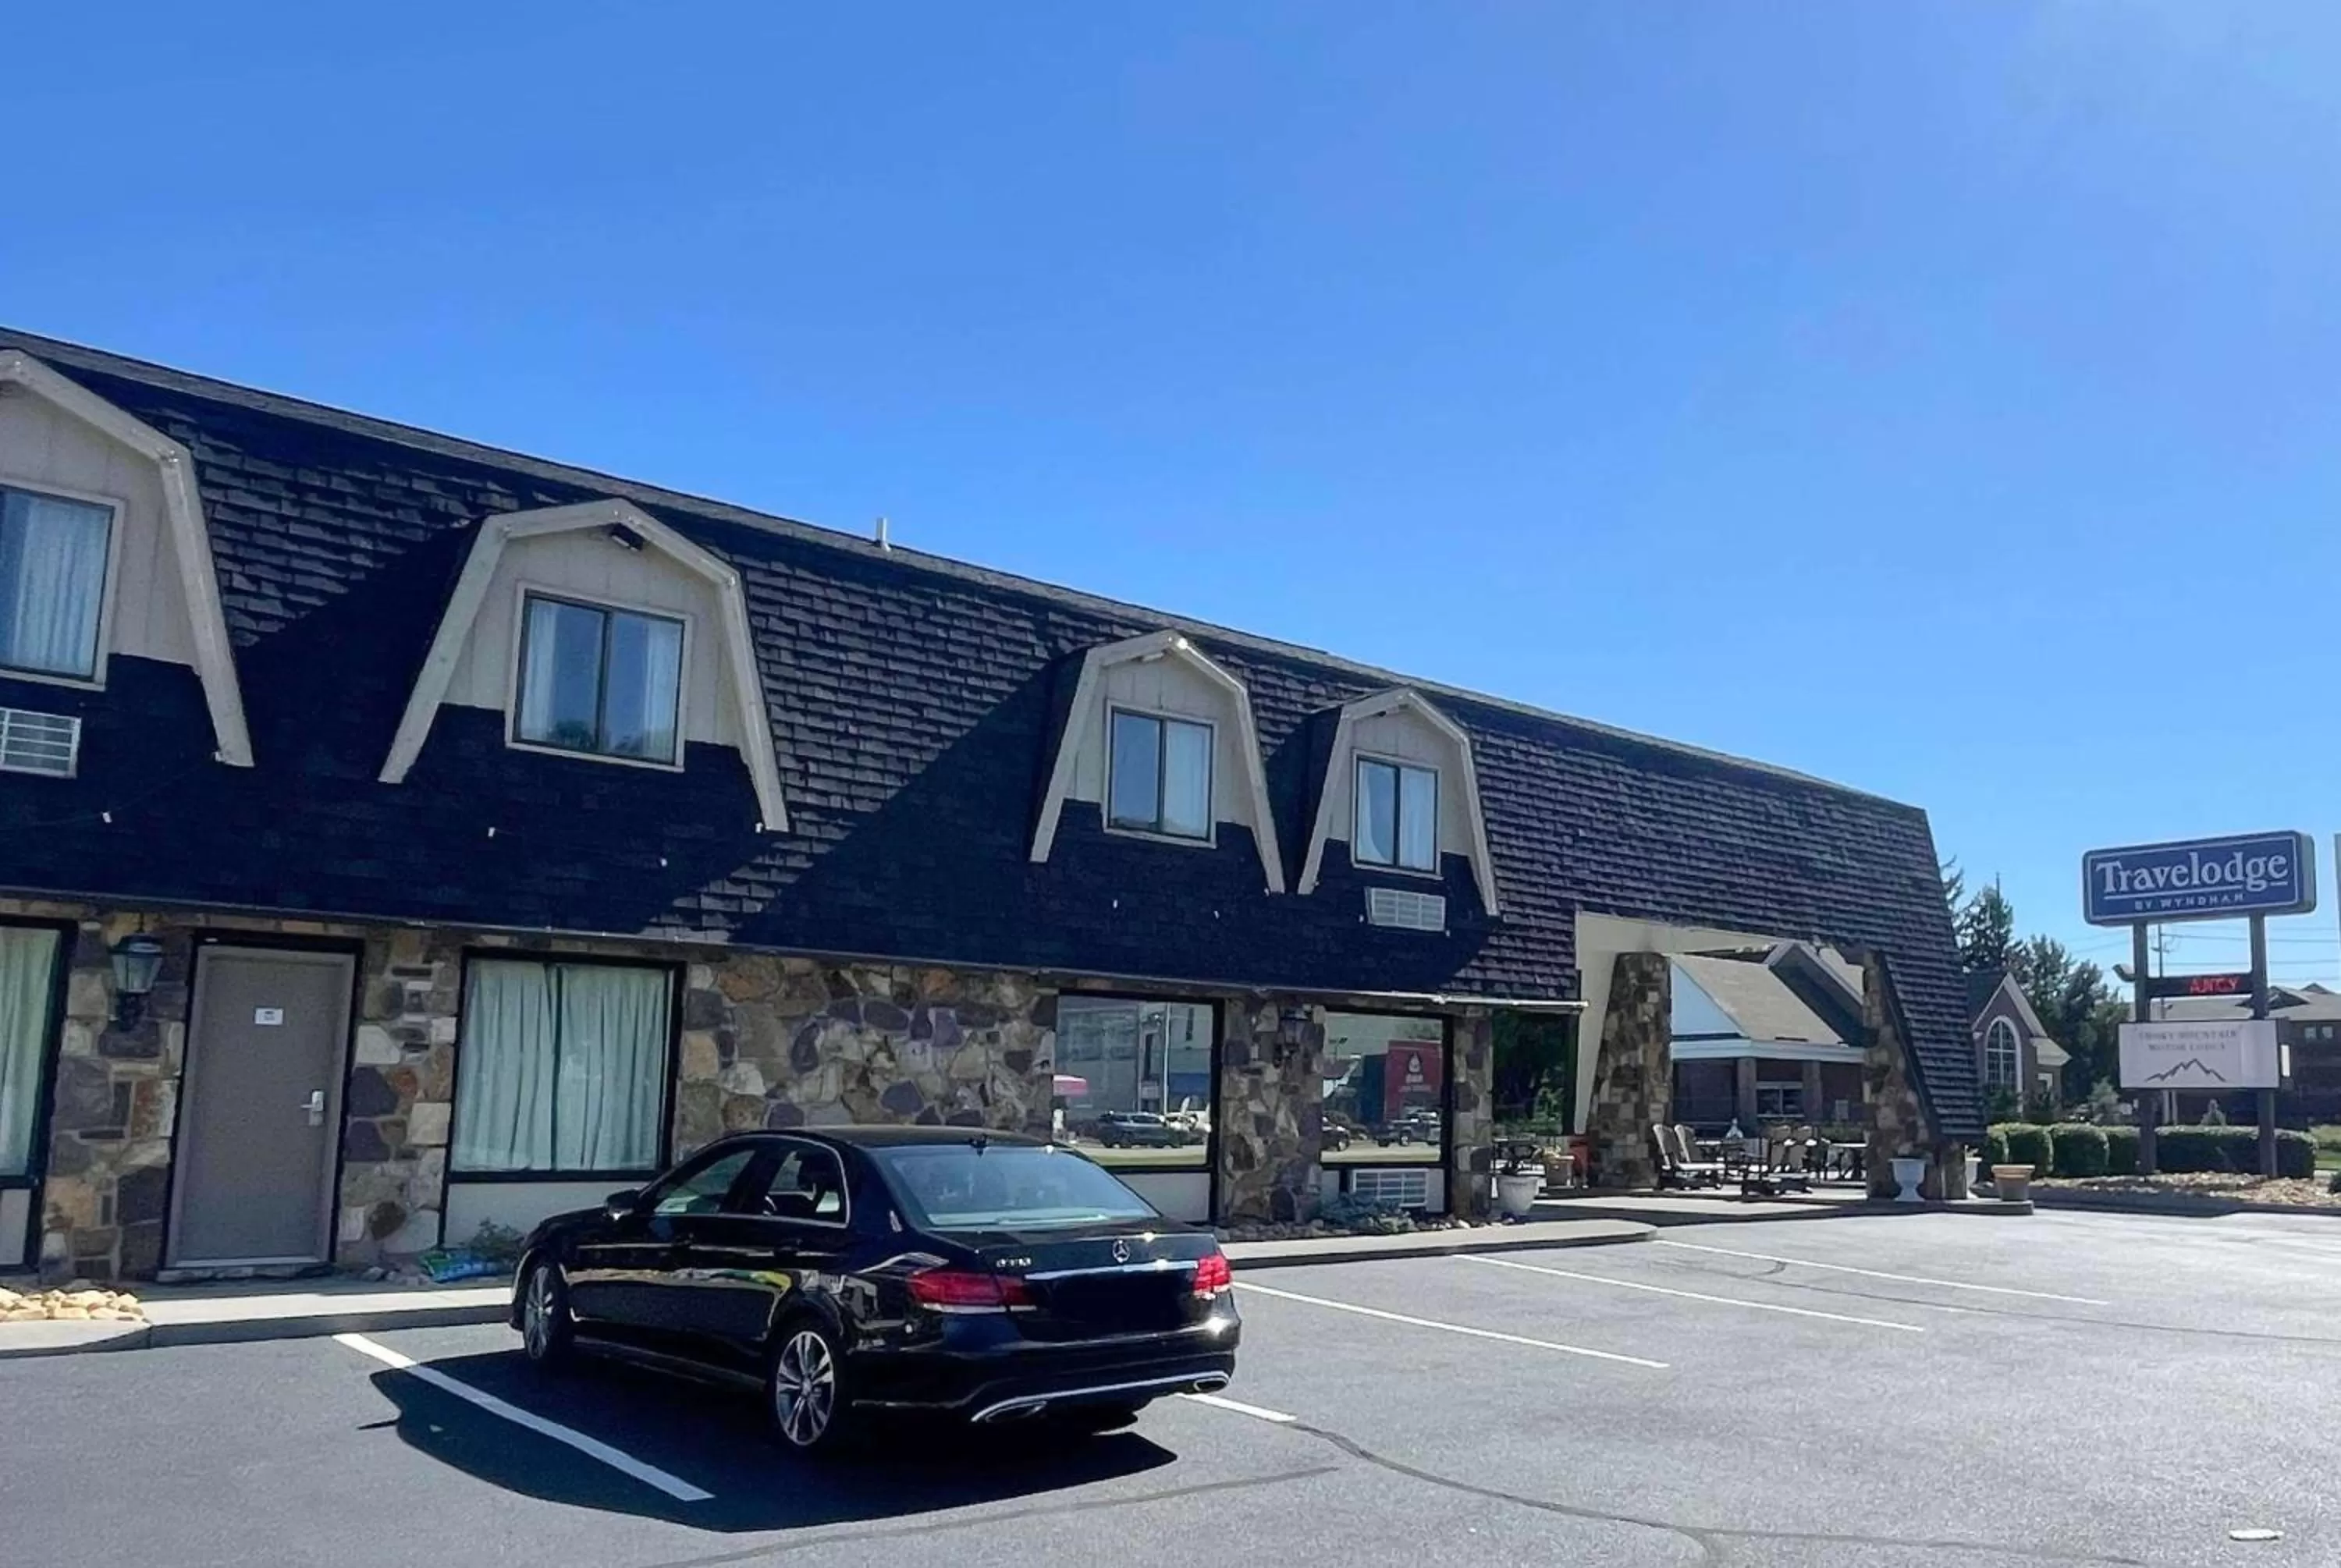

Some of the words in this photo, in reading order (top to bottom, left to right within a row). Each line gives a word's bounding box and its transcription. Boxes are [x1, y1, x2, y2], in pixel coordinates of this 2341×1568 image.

[2095, 851, 2289, 893] Travelodge
[2134, 899, 2152, 911] BY
[2160, 892, 2244, 909] WYNDHAM
